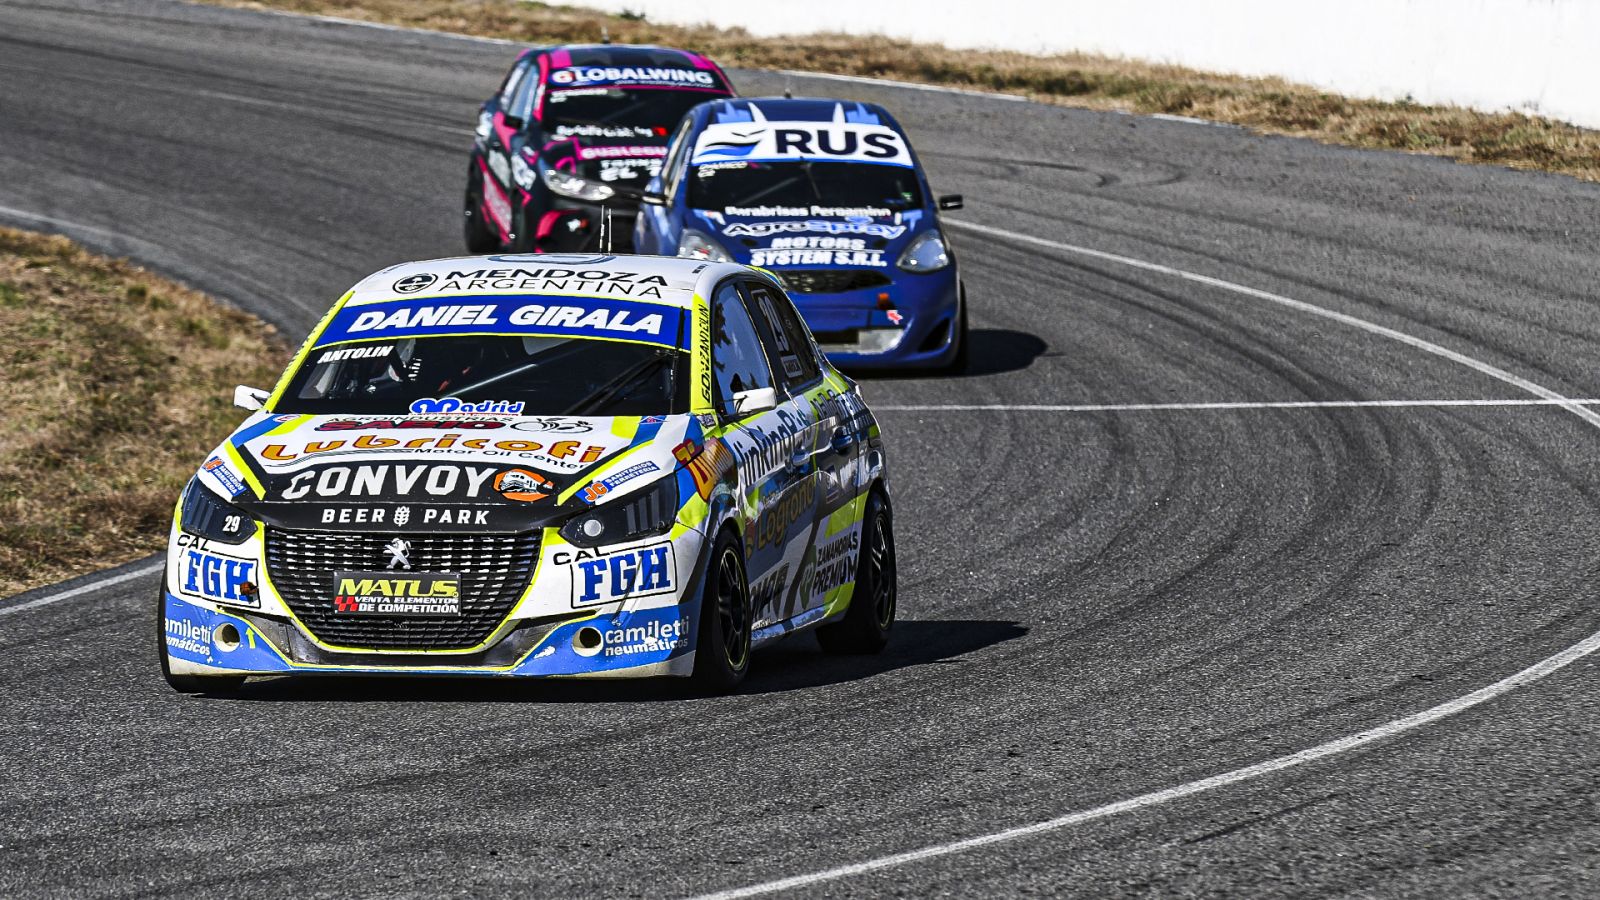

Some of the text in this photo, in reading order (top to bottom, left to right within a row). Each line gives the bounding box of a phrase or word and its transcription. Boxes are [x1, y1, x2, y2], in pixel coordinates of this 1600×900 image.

[551, 68, 713, 84] GLOBALWING
[774, 129, 899, 158] RUS
[722, 219, 907, 239] AgroSpray
[771, 237, 867, 250] MOTORS
[750, 251, 833, 266] SYSTEM
[445, 269, 668, 286] MENDOZA
[438, 278, 662, 298] ARGENTINA
[347, 304, 663, 335] DANIEL GIRALA
[317, 345, 394, 364] ANTOLIN
[410, 398, 524, 414] Madrid
[261, 434, 606, 462] Lubricofi
[483, 449, 511, 457] Oil
[524, 453, 590, 470] Center
[281, 465, 498, 499] CONVOY
[222, 515, 241, 533] 29
[322, 508, 490, 525] BEER PARK
[177, 534, 210, 551] CAL
[553, 547, 610, 565] CAL
[185, 550, 254, 603] FGH
[578, 547, 671, 602] FGH
[812, 554, 858, 597] PREMIUM
[338, 579, 458, 597] MATUS
[358, 603, 459, 613] DE COMPETICIÓN
[605, 615, 690, 644] camiletti
